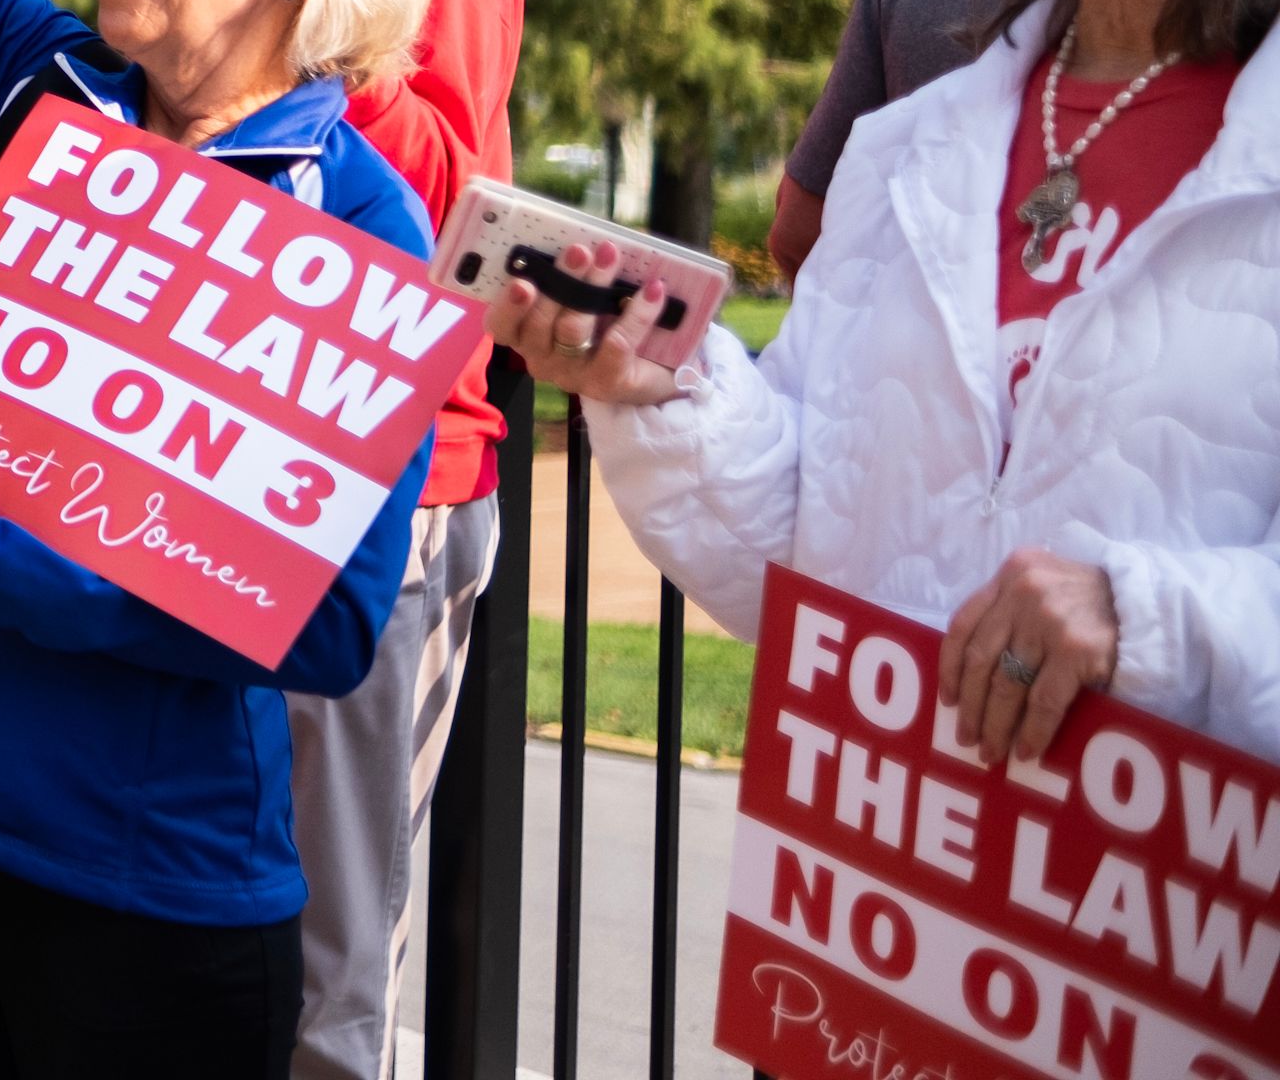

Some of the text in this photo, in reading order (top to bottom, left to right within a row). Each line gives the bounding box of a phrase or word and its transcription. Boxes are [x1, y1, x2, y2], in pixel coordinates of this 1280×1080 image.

[27, 121, 467, 363] FOLLOW
[168, 280, 416, 440] LAW
[91, 369, 248, 482] ON
[263, 458, 337, 528] 3
[60, 463, 277, 609] Women
[776, 709, 1280, 1016] THE LAW
[752, 963, 956, 1080] Prote
[770, 844, 1137, 1080] NO ON
